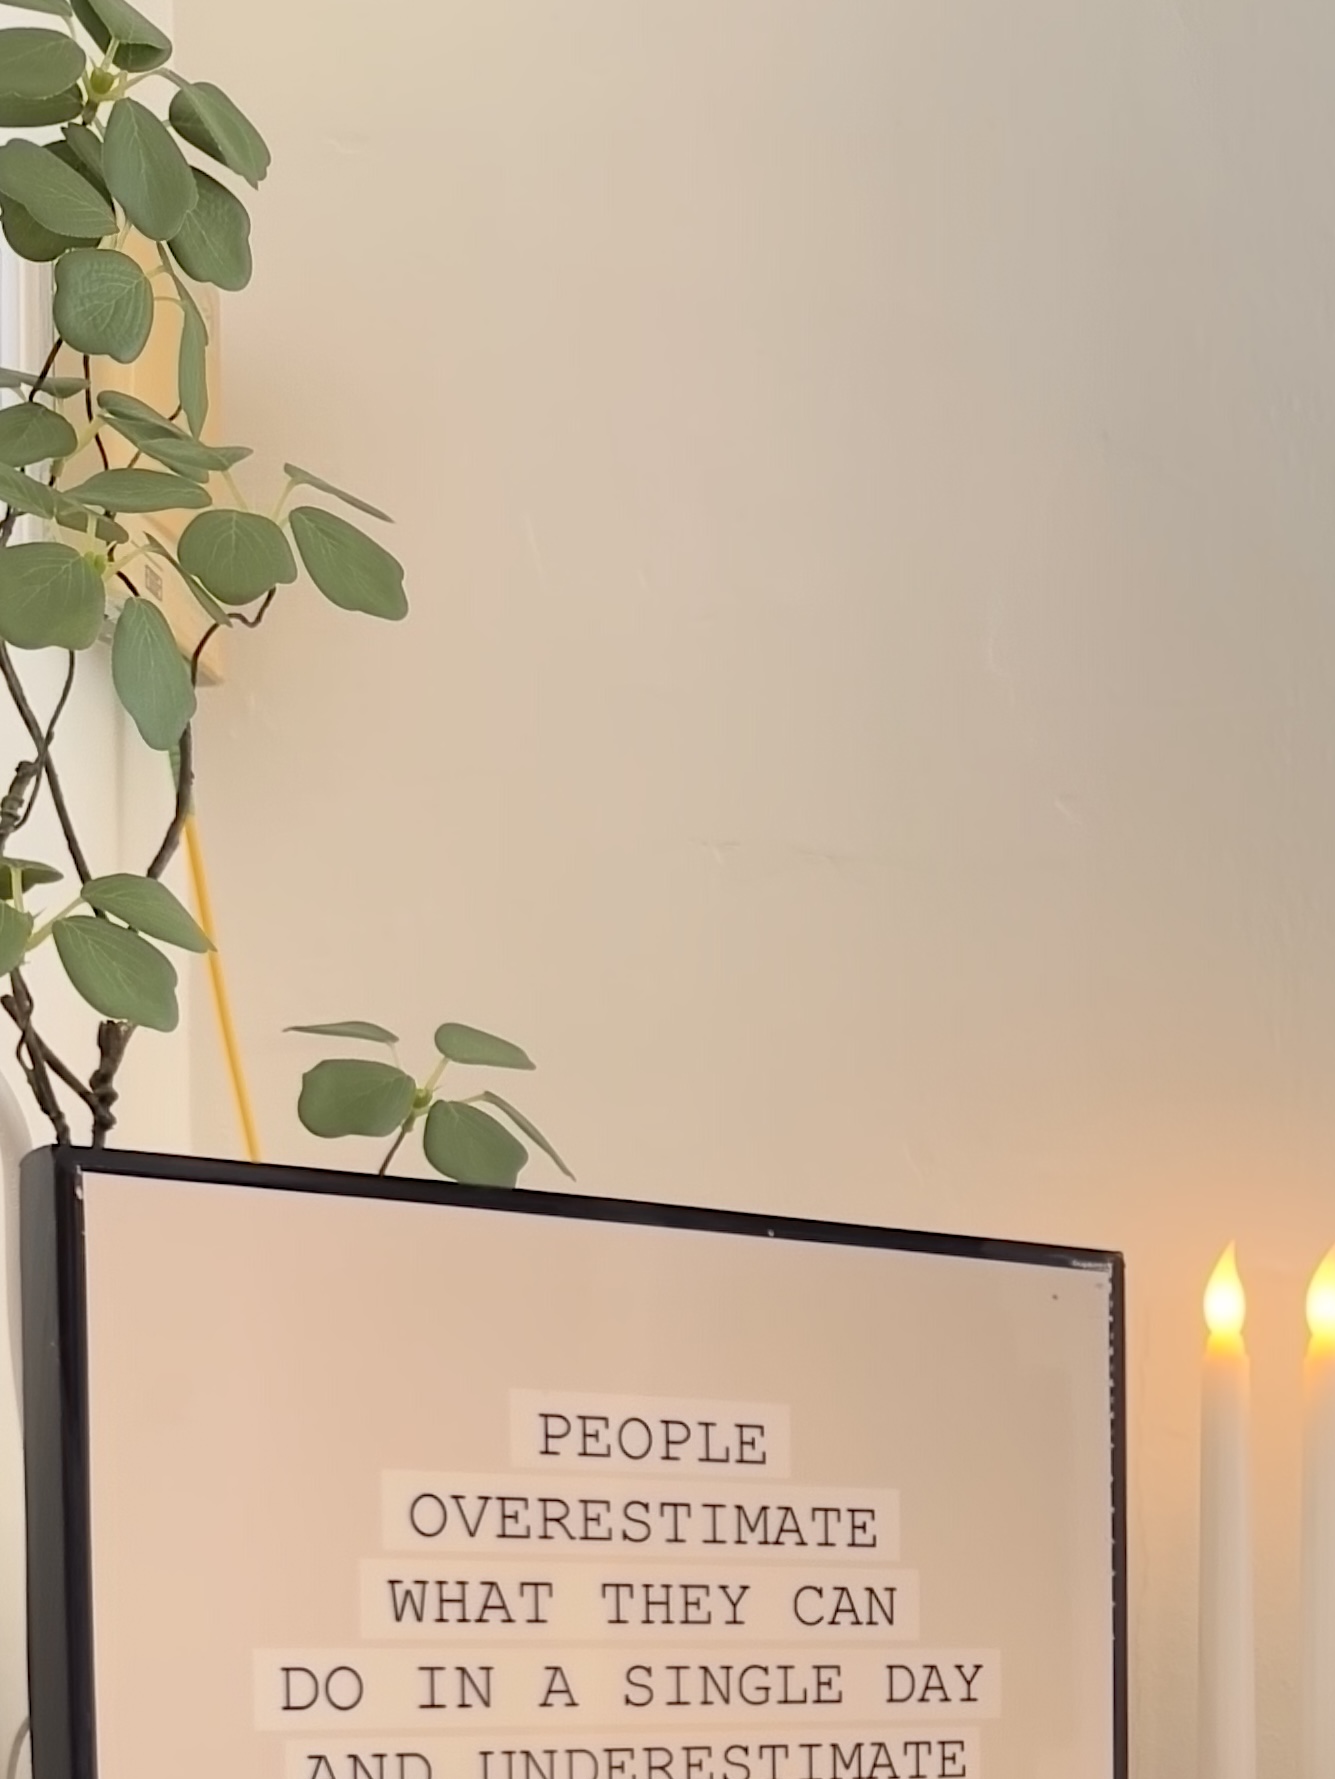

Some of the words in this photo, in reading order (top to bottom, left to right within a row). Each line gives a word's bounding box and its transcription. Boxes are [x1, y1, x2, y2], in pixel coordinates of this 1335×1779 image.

[538, 1412, 767, 1465] PEOPLE
[409, 1492, 878, 1548] OVERESTIMATE
[386, 1579, 553, 1624] WHAT
[601, 1582, 751, 1625] THEY
[793, 1585, 898, 1627] CAN
[280, 1666, 364, 1712] DO
[417, 1666, 495, 1710] IN
[538, 1666, 580, 1708] A
[624, 1664, 843, 1707] SINGLE
[885, 1663, 984, 1704] DAY
